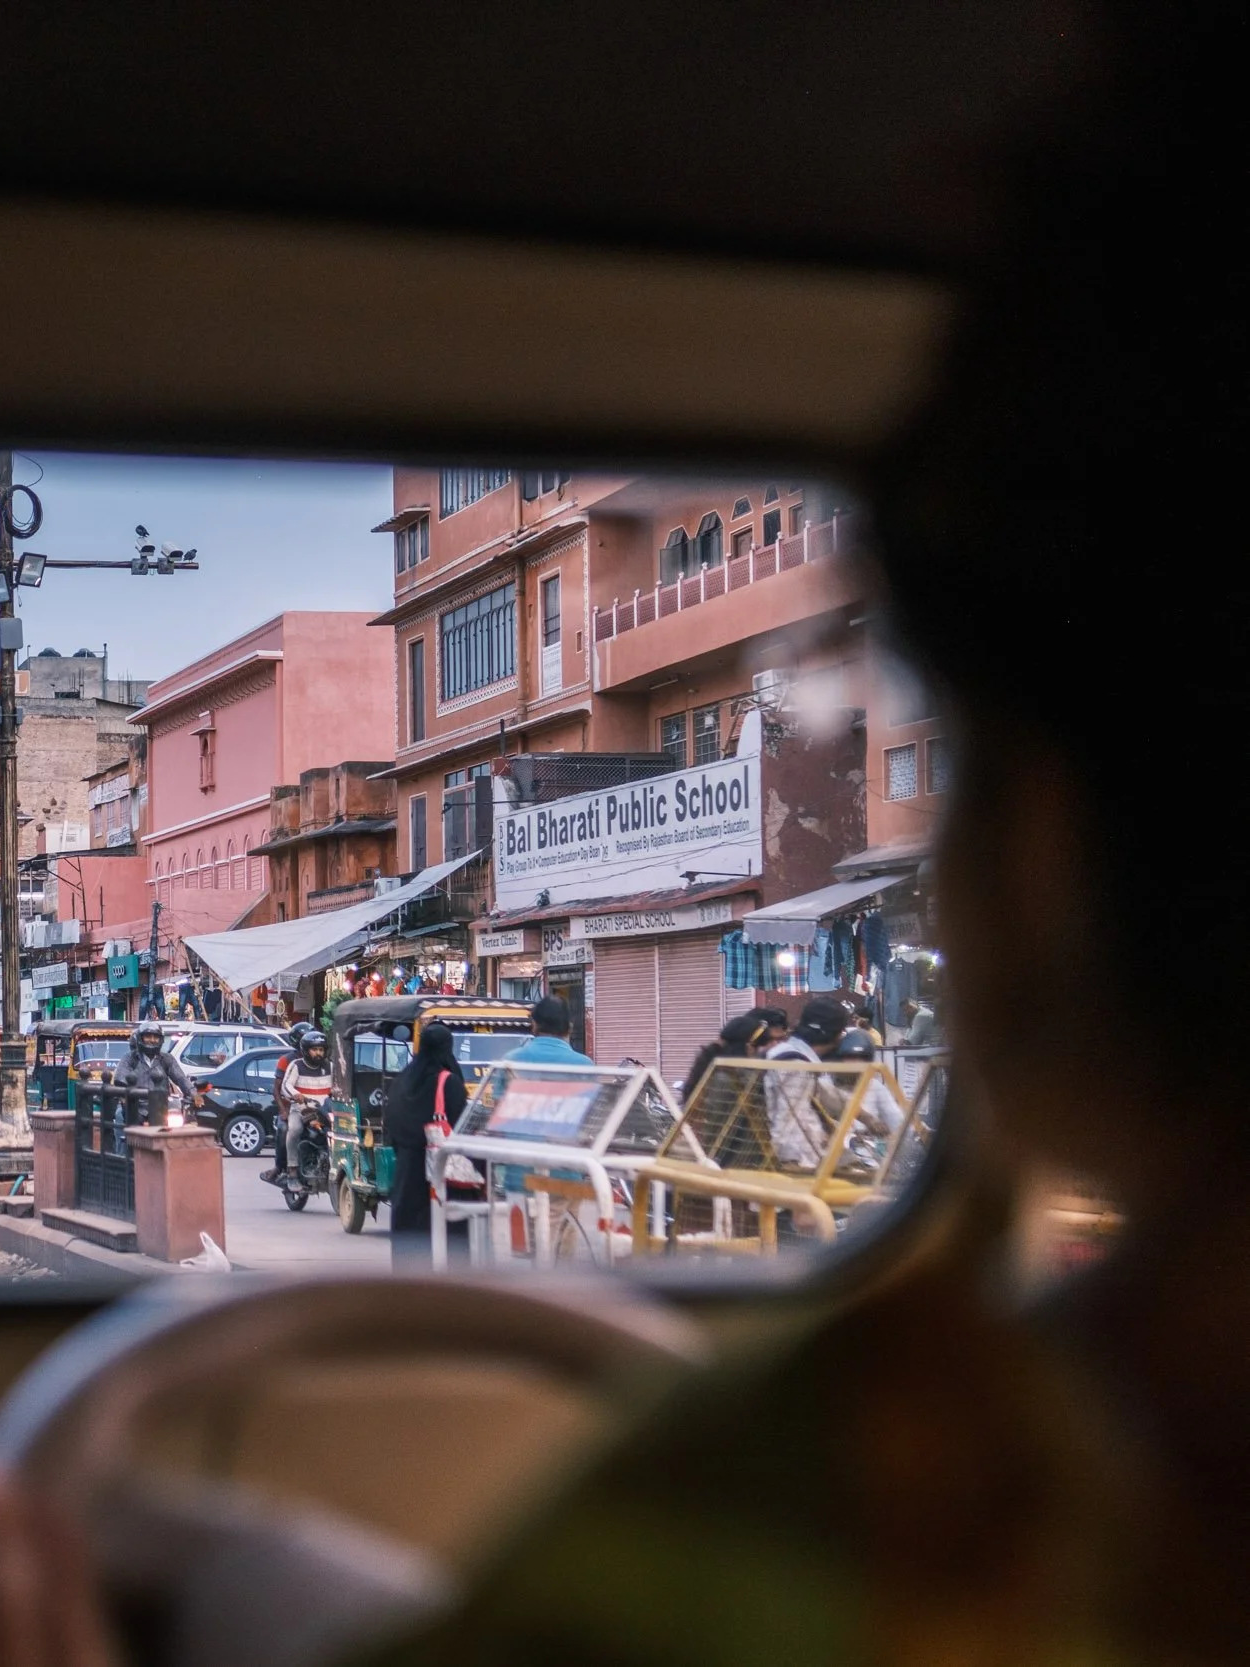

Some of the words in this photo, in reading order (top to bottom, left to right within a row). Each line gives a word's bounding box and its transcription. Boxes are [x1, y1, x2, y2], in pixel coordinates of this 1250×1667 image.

[506, 814, 531, 856] Bal
[537, 798, 600, 849] Bharati
[607, 786, 667, 835] Public
[675, 764, 749, 822] School
[615, 836, 642, 855] Recognised
[643, 834, 650, 853] By
[650, 832, 674, 851] Rajasthan
[674, 828, 689, 844] Board
[696, 824, 722, 839] Secondary
[723, 819, 749, 834] Education
[557, 850, 578, 865] Education
[580, 846, 588, 863] Day
[584, 917, 614, 934] BHARATI
[614, 912, 645, 931] SPECIAL
[645, 910, 676, 928] SCHOOL
[481, 936, 499, 949] Vertex
[500, 932, 518, 947] Clinic
[543, 928, 563, 953] BPS
